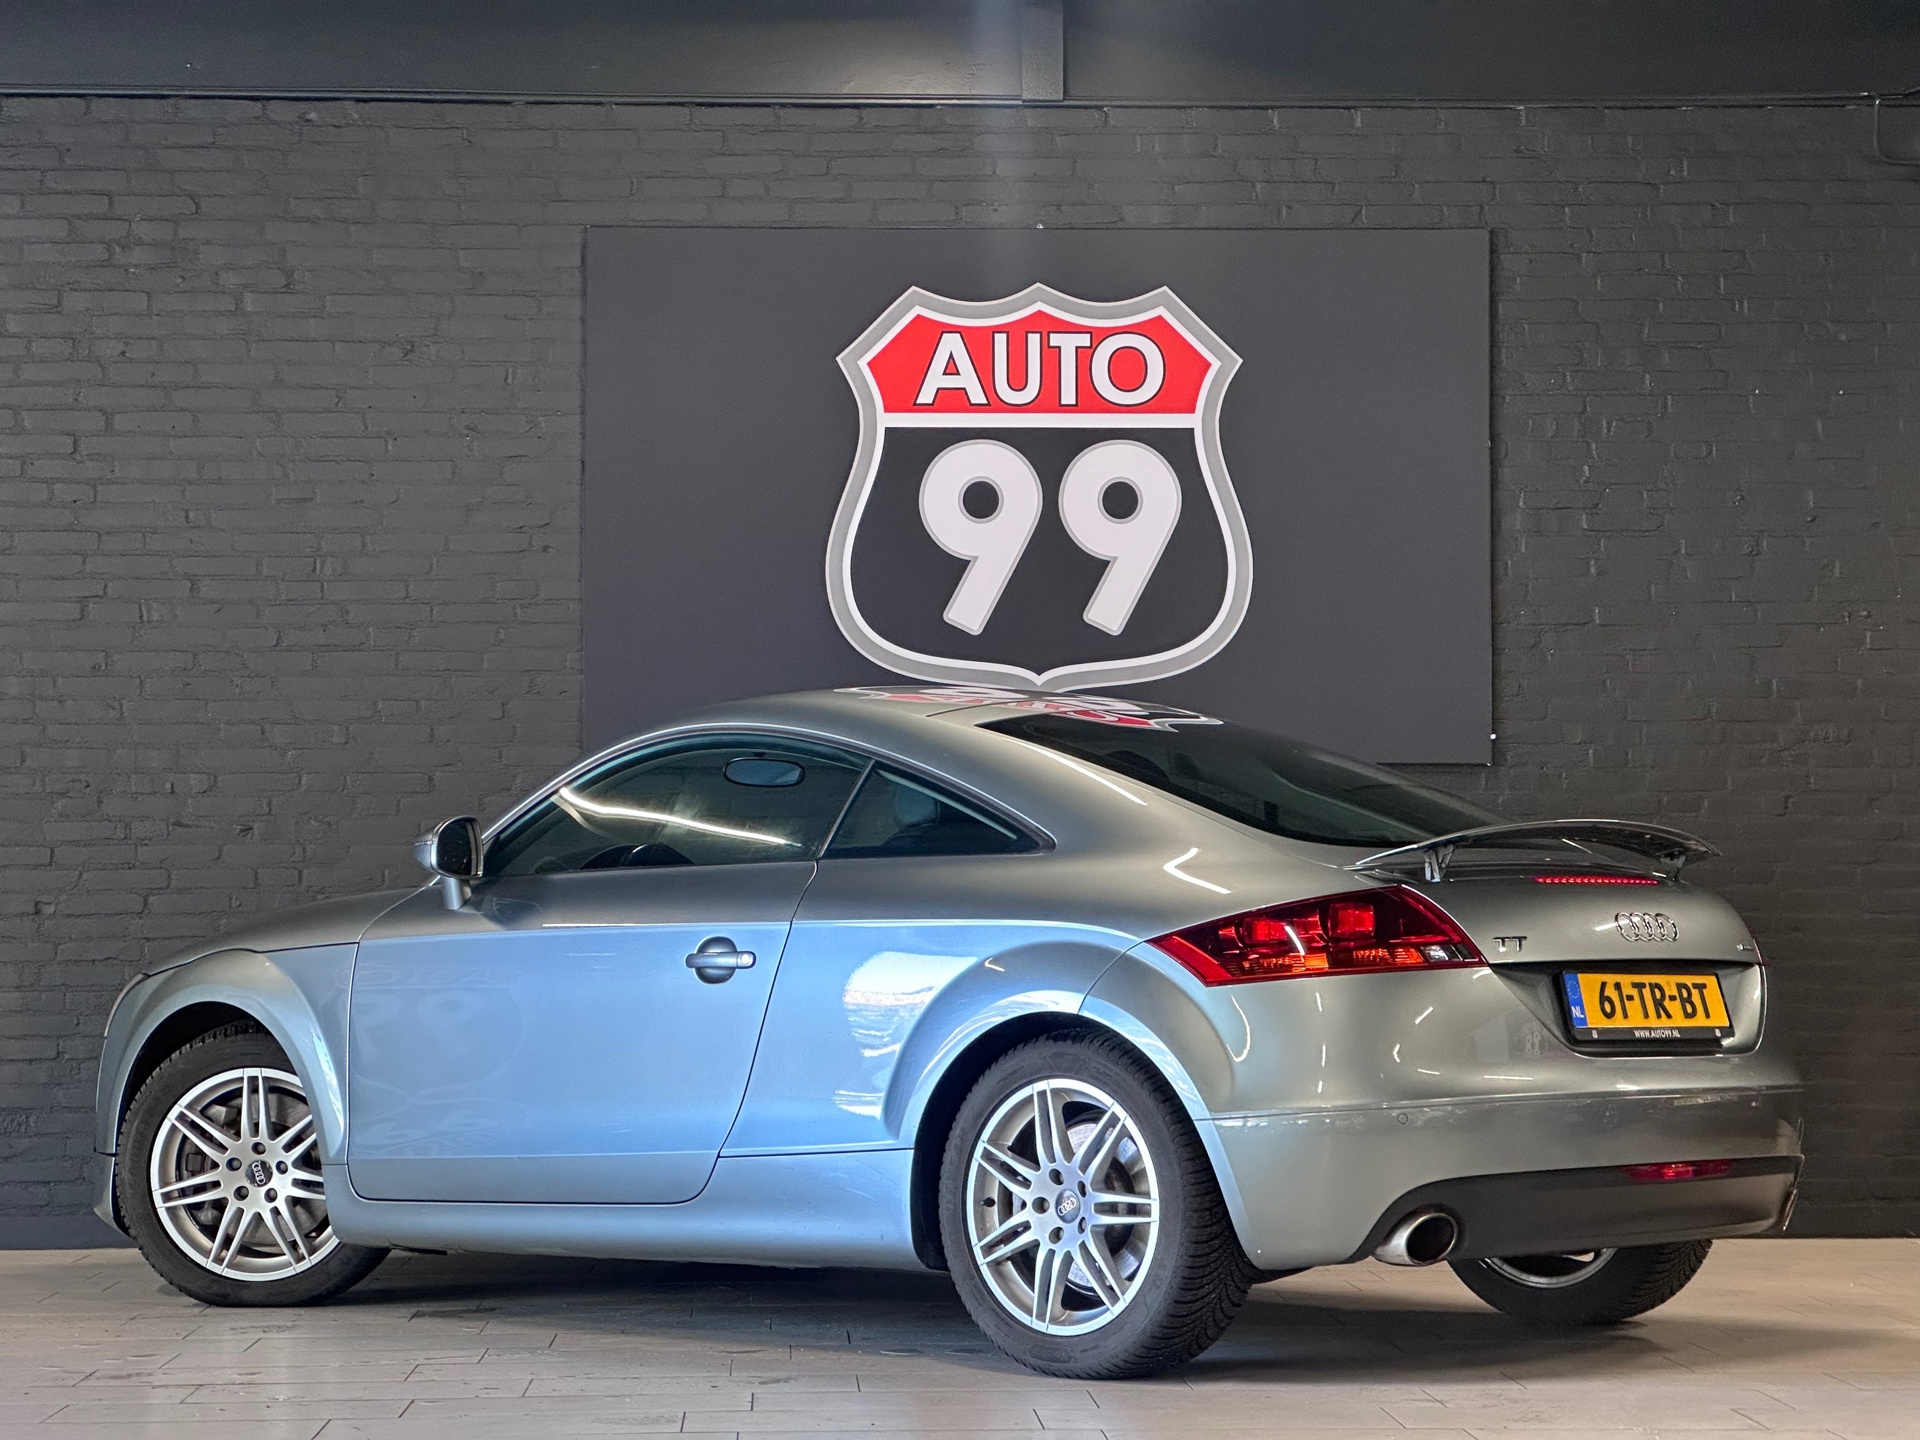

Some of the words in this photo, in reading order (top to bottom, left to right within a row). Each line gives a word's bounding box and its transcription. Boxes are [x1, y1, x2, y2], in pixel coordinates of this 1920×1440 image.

[913, 331, 1165, 407] AUTO
[919, 439, 1182, 636] 99
[1493, 936, 1527, 952] TT
[1572, 1006, 1584, 1018] NL
[1599, 981, 1711, 1019] 61-TR-BT
